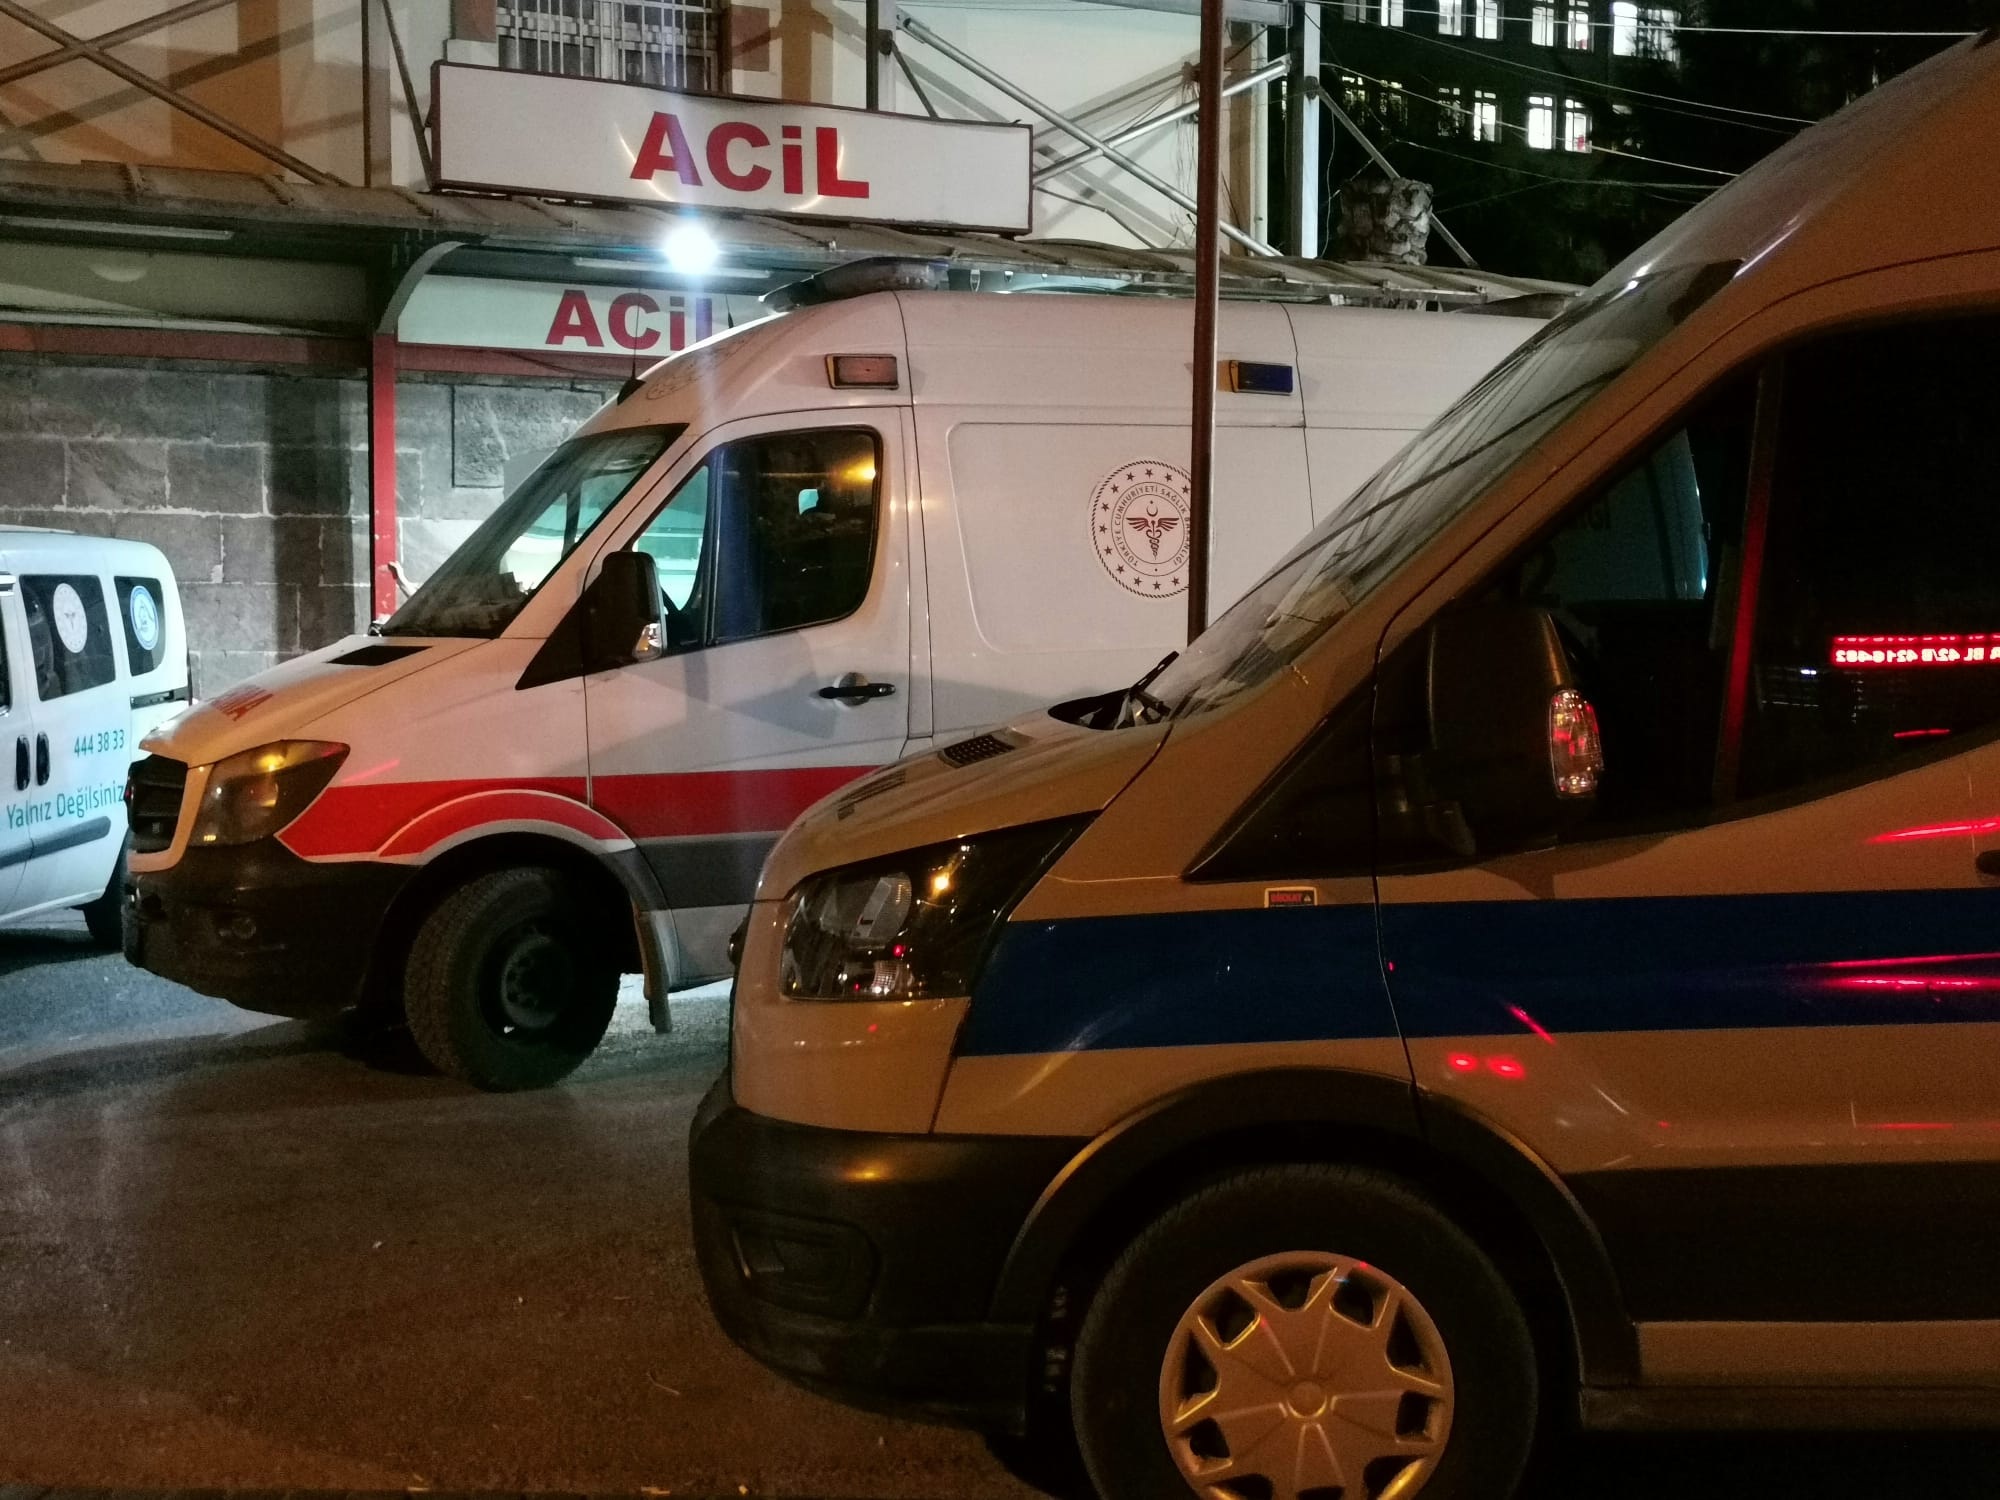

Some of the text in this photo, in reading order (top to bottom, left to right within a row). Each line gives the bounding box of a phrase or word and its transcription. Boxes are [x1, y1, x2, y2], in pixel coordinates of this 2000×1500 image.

[74, 729, 125, 758] 444 38 33
[6, 780, 125, 829] Yalnız Değilsiniz
